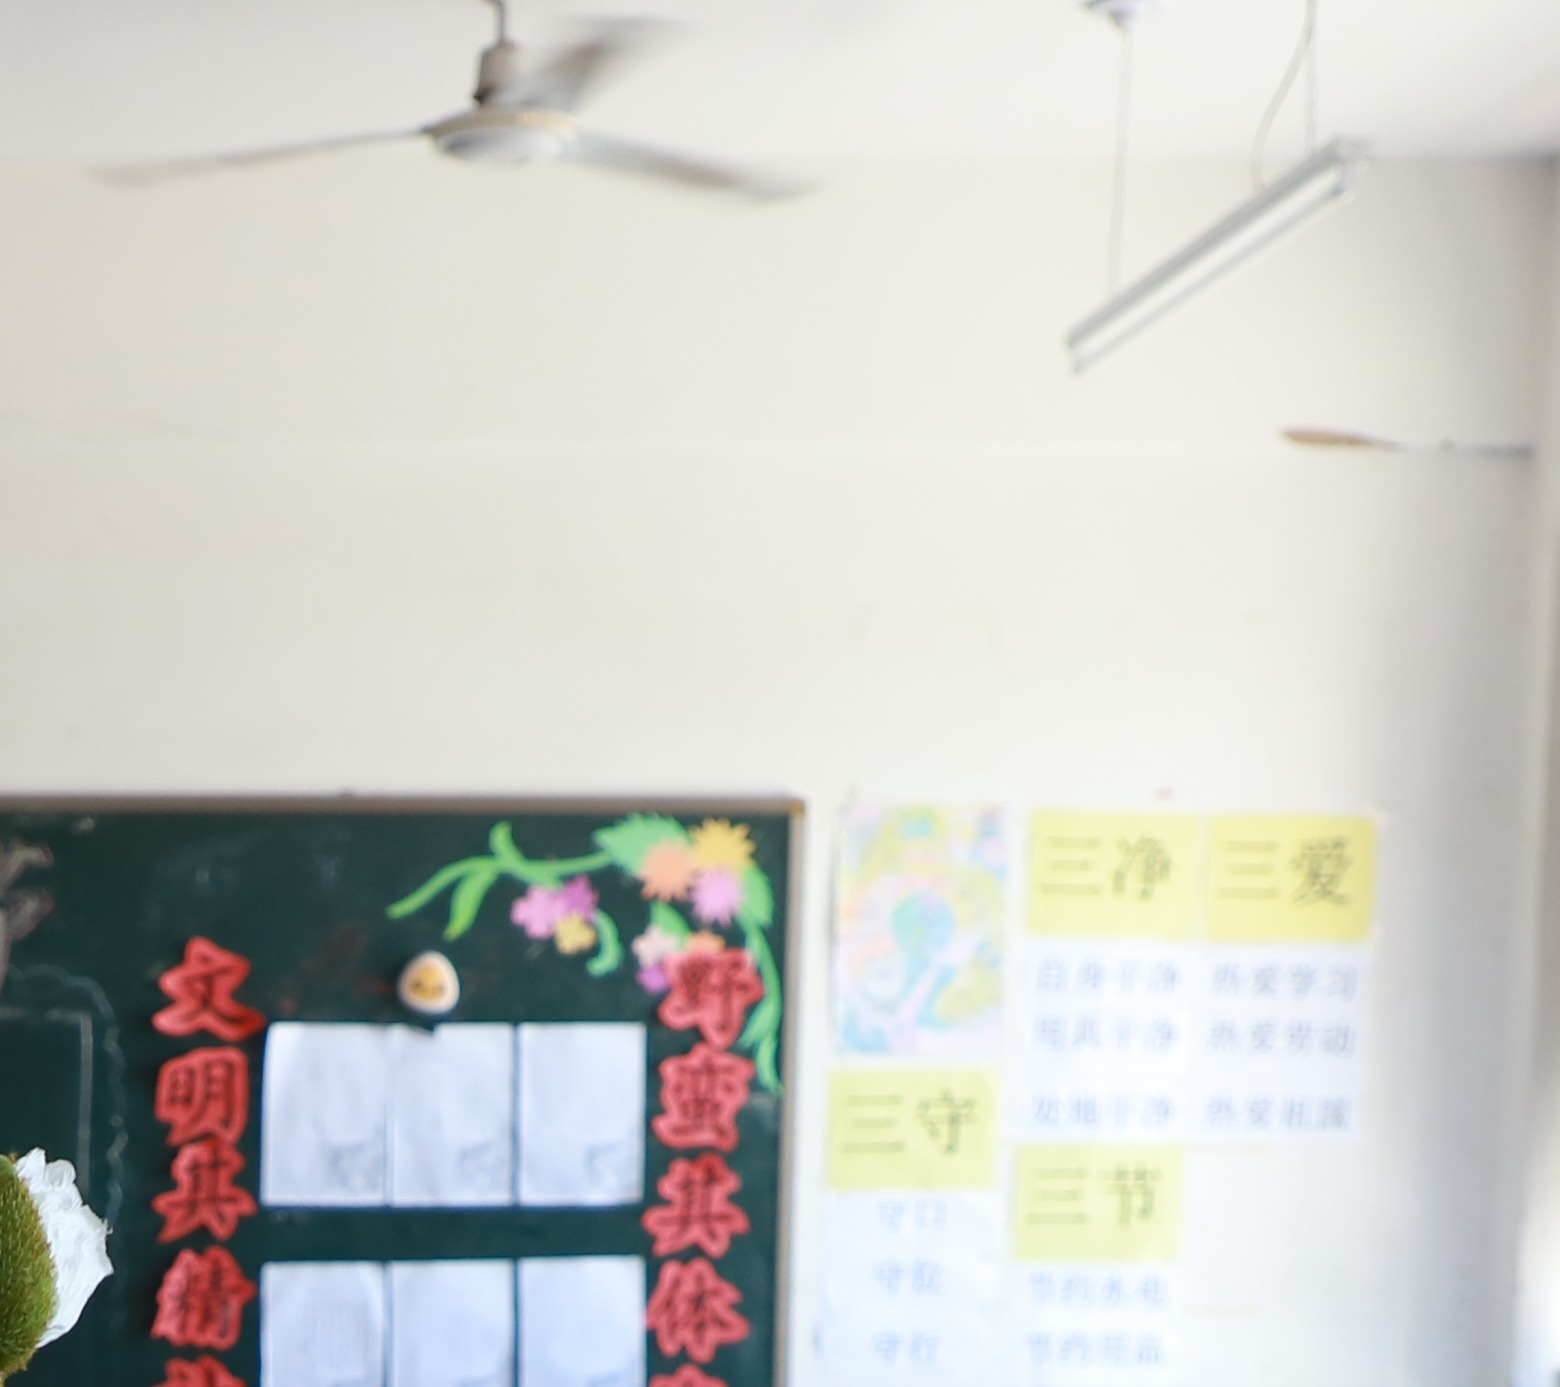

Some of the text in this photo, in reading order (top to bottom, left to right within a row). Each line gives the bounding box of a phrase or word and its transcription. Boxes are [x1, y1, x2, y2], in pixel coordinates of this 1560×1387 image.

[1040, 832, 1172, 900] 三净
[1217, 838, 1354, 908] 三爱
[842, 1089, 976, 1156] 三守
[1025, 1162, 1162, 1228] 三节
